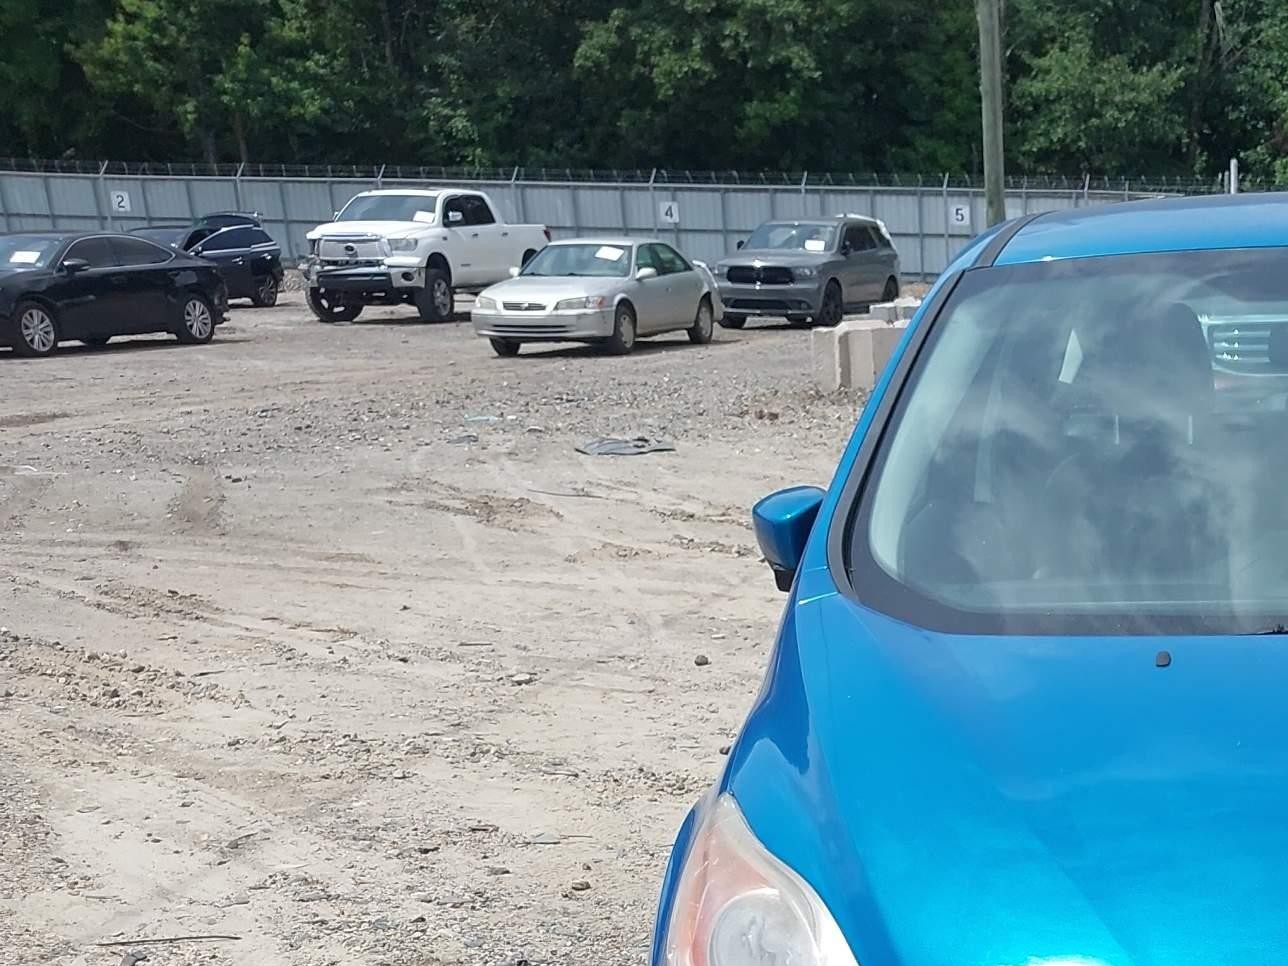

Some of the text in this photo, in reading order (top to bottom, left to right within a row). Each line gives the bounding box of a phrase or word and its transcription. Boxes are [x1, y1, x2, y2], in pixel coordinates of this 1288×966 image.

[116, 194, 126, 209] 2
[664, 204, 674, 219] 4
[955, 207, 965, 222] 5
